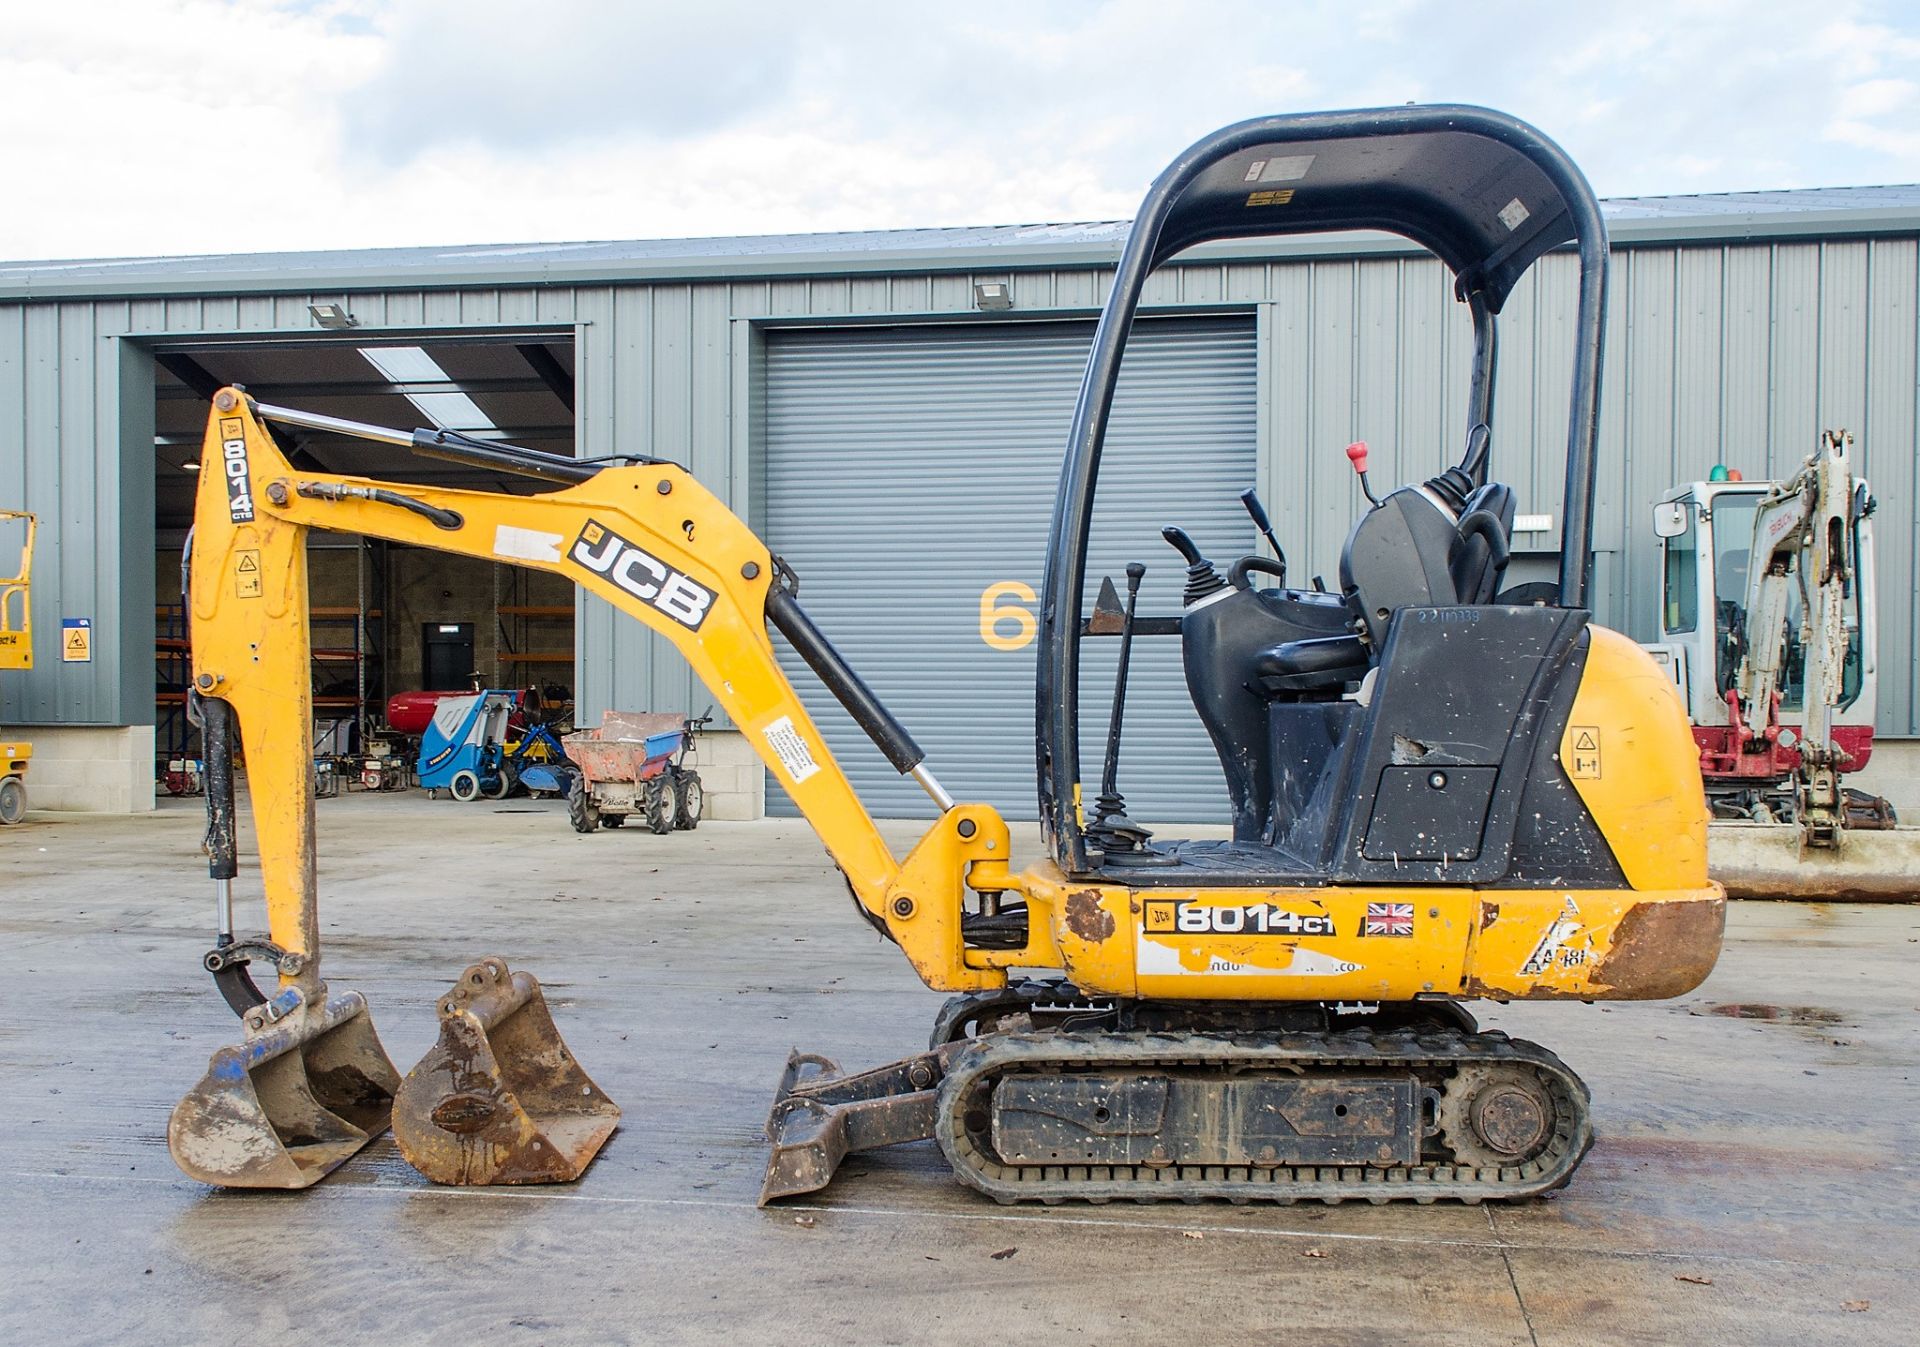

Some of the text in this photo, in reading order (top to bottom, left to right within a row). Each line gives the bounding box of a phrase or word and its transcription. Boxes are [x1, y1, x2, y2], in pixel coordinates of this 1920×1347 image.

[223, 440, 252, 512] 8014
[574, 536, 711, 626] JCB
[980, 581, 1037, 651] 6
[1154, 910, 1170, 924] JCB
